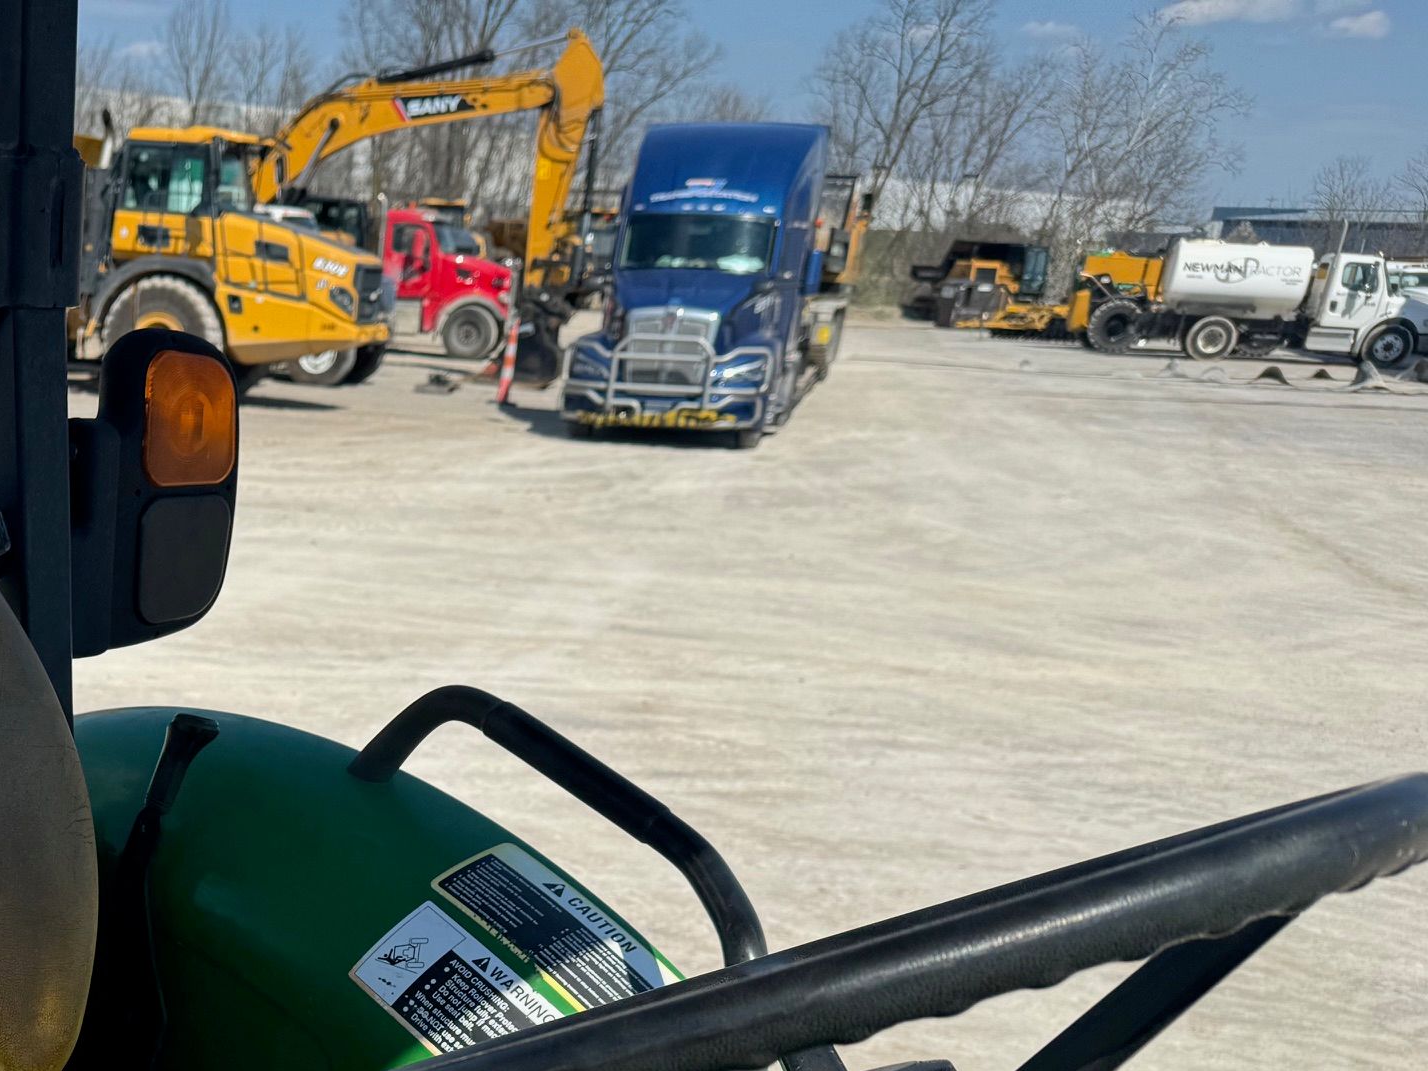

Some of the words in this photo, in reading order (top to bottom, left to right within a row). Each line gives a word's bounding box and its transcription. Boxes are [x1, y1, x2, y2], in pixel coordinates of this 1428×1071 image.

[406, 94, 463, 117] SANY
[1183, 262, 1242, 274] NEWMAN
[568, 896, 638, 953] CAUTION
[432, 991, 446, 1005] Use
[445, 1004, 461, 1019] seat
[445, 979, 476, 1008] Structure
[474, 1005, 491, 1022] fully
[449, 959, 472, 979] AVOID
[470, 978, 510, 1013] CRUSHING:
[451, 974, 470, 991] Keep
[468, 989, 498, 1014] Rollover
[410, 1013, 429, 1031] Drive
[427, 1029, 443, 1045] with
[414, 990, 434, 1010] When
[432, 1008, 462, 1036] structure
[438, 985, 450, 997] Do
[448, 995, 462, 1007] not
[458, 1004, 478, 1022] jump
[481, 1025, 501, 1039] mac
[442, 1029, 455, 1043] use
